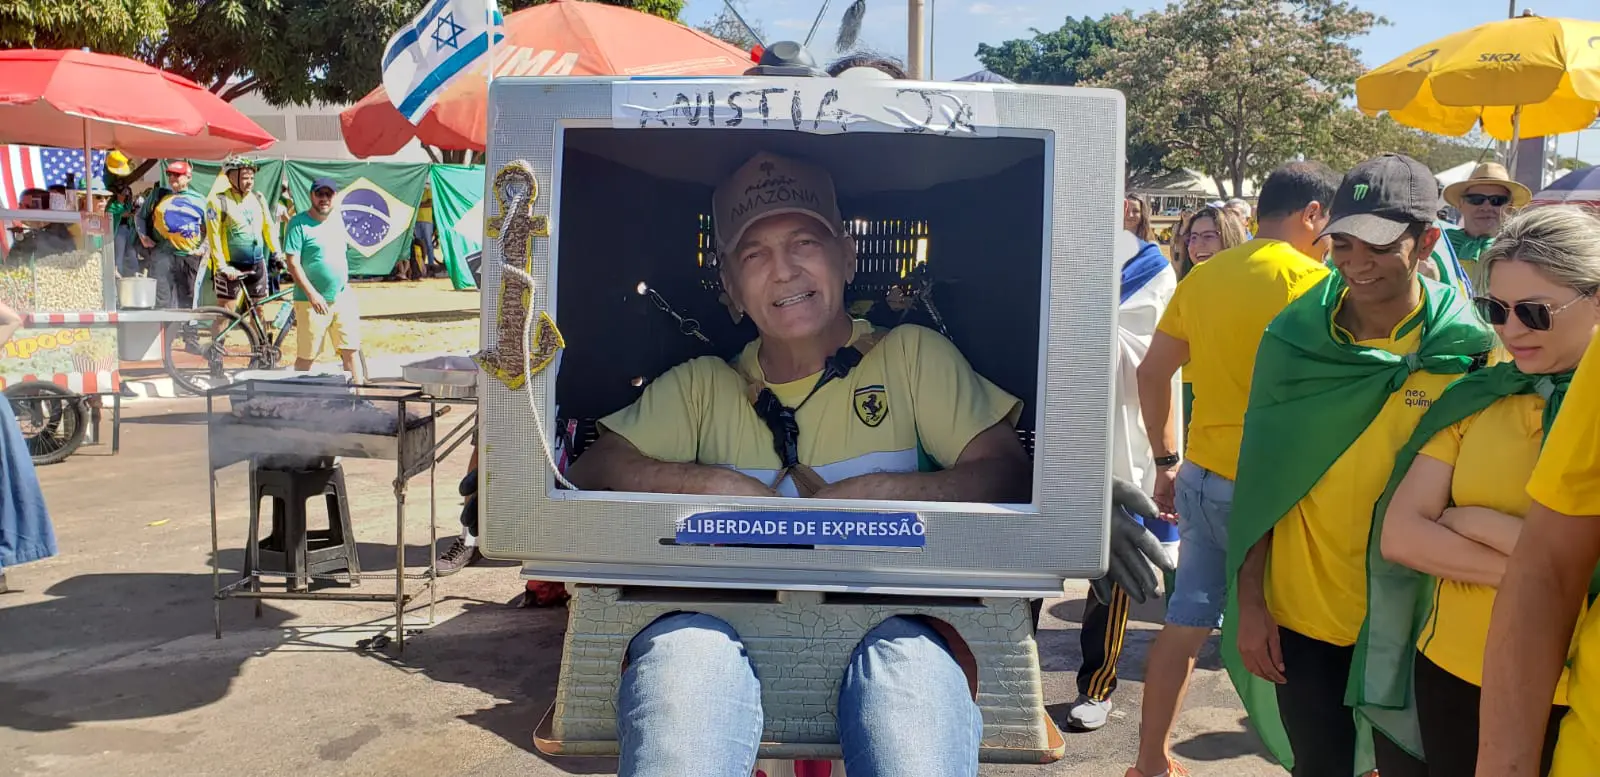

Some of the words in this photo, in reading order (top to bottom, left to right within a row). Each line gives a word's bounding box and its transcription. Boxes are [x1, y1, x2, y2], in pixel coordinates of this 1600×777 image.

[492, 44, 579, 76] MA
[1476, 52, 1521, 63] SKOL
[730, 184, 820, 222] AMAZÔNIA
[4, 327, 92, 359] ipoca
[1405, 389, 1426, 397] neo
[675, 518, 788, 536] #LIBERDADE
[793, 520, 816, 536] DE
[822, 517, 926, 537] EXPRESSÃO
